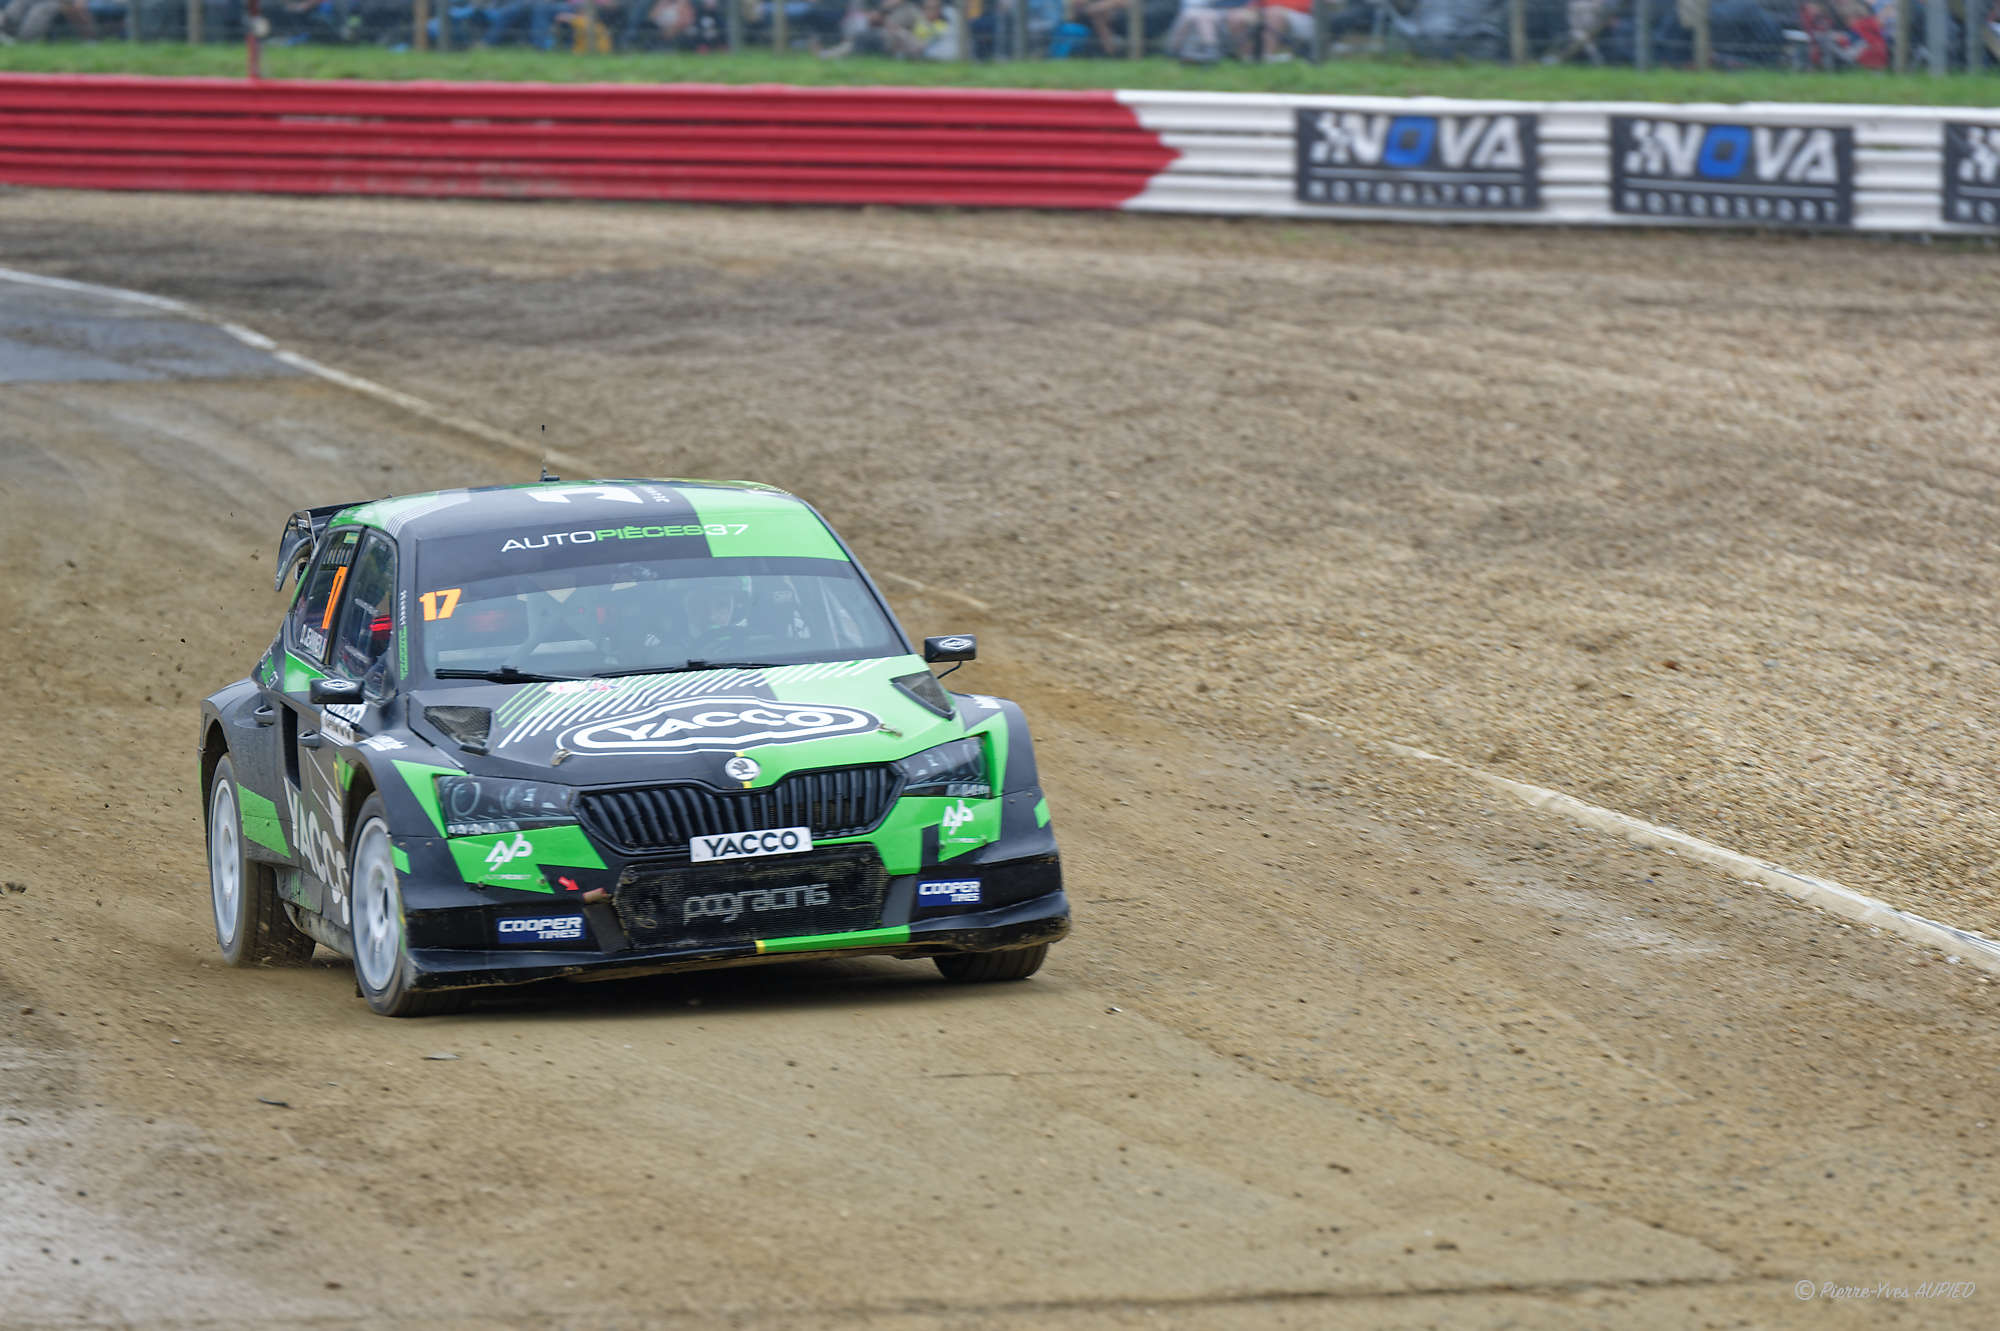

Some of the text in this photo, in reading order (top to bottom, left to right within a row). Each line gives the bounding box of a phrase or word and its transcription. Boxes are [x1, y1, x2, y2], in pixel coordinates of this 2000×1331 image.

[1340, 112, 1526, 168] NOVA
[1653, 119, 1838, 184] NOVA
[418, 588, 462, 621] 17
[607, 708, 834, 741] YACCO
[703, 830, 799, 858] YACCO
[499, 917, 582, 933] COOPER
[537, 928, 581, 940] TIRES
